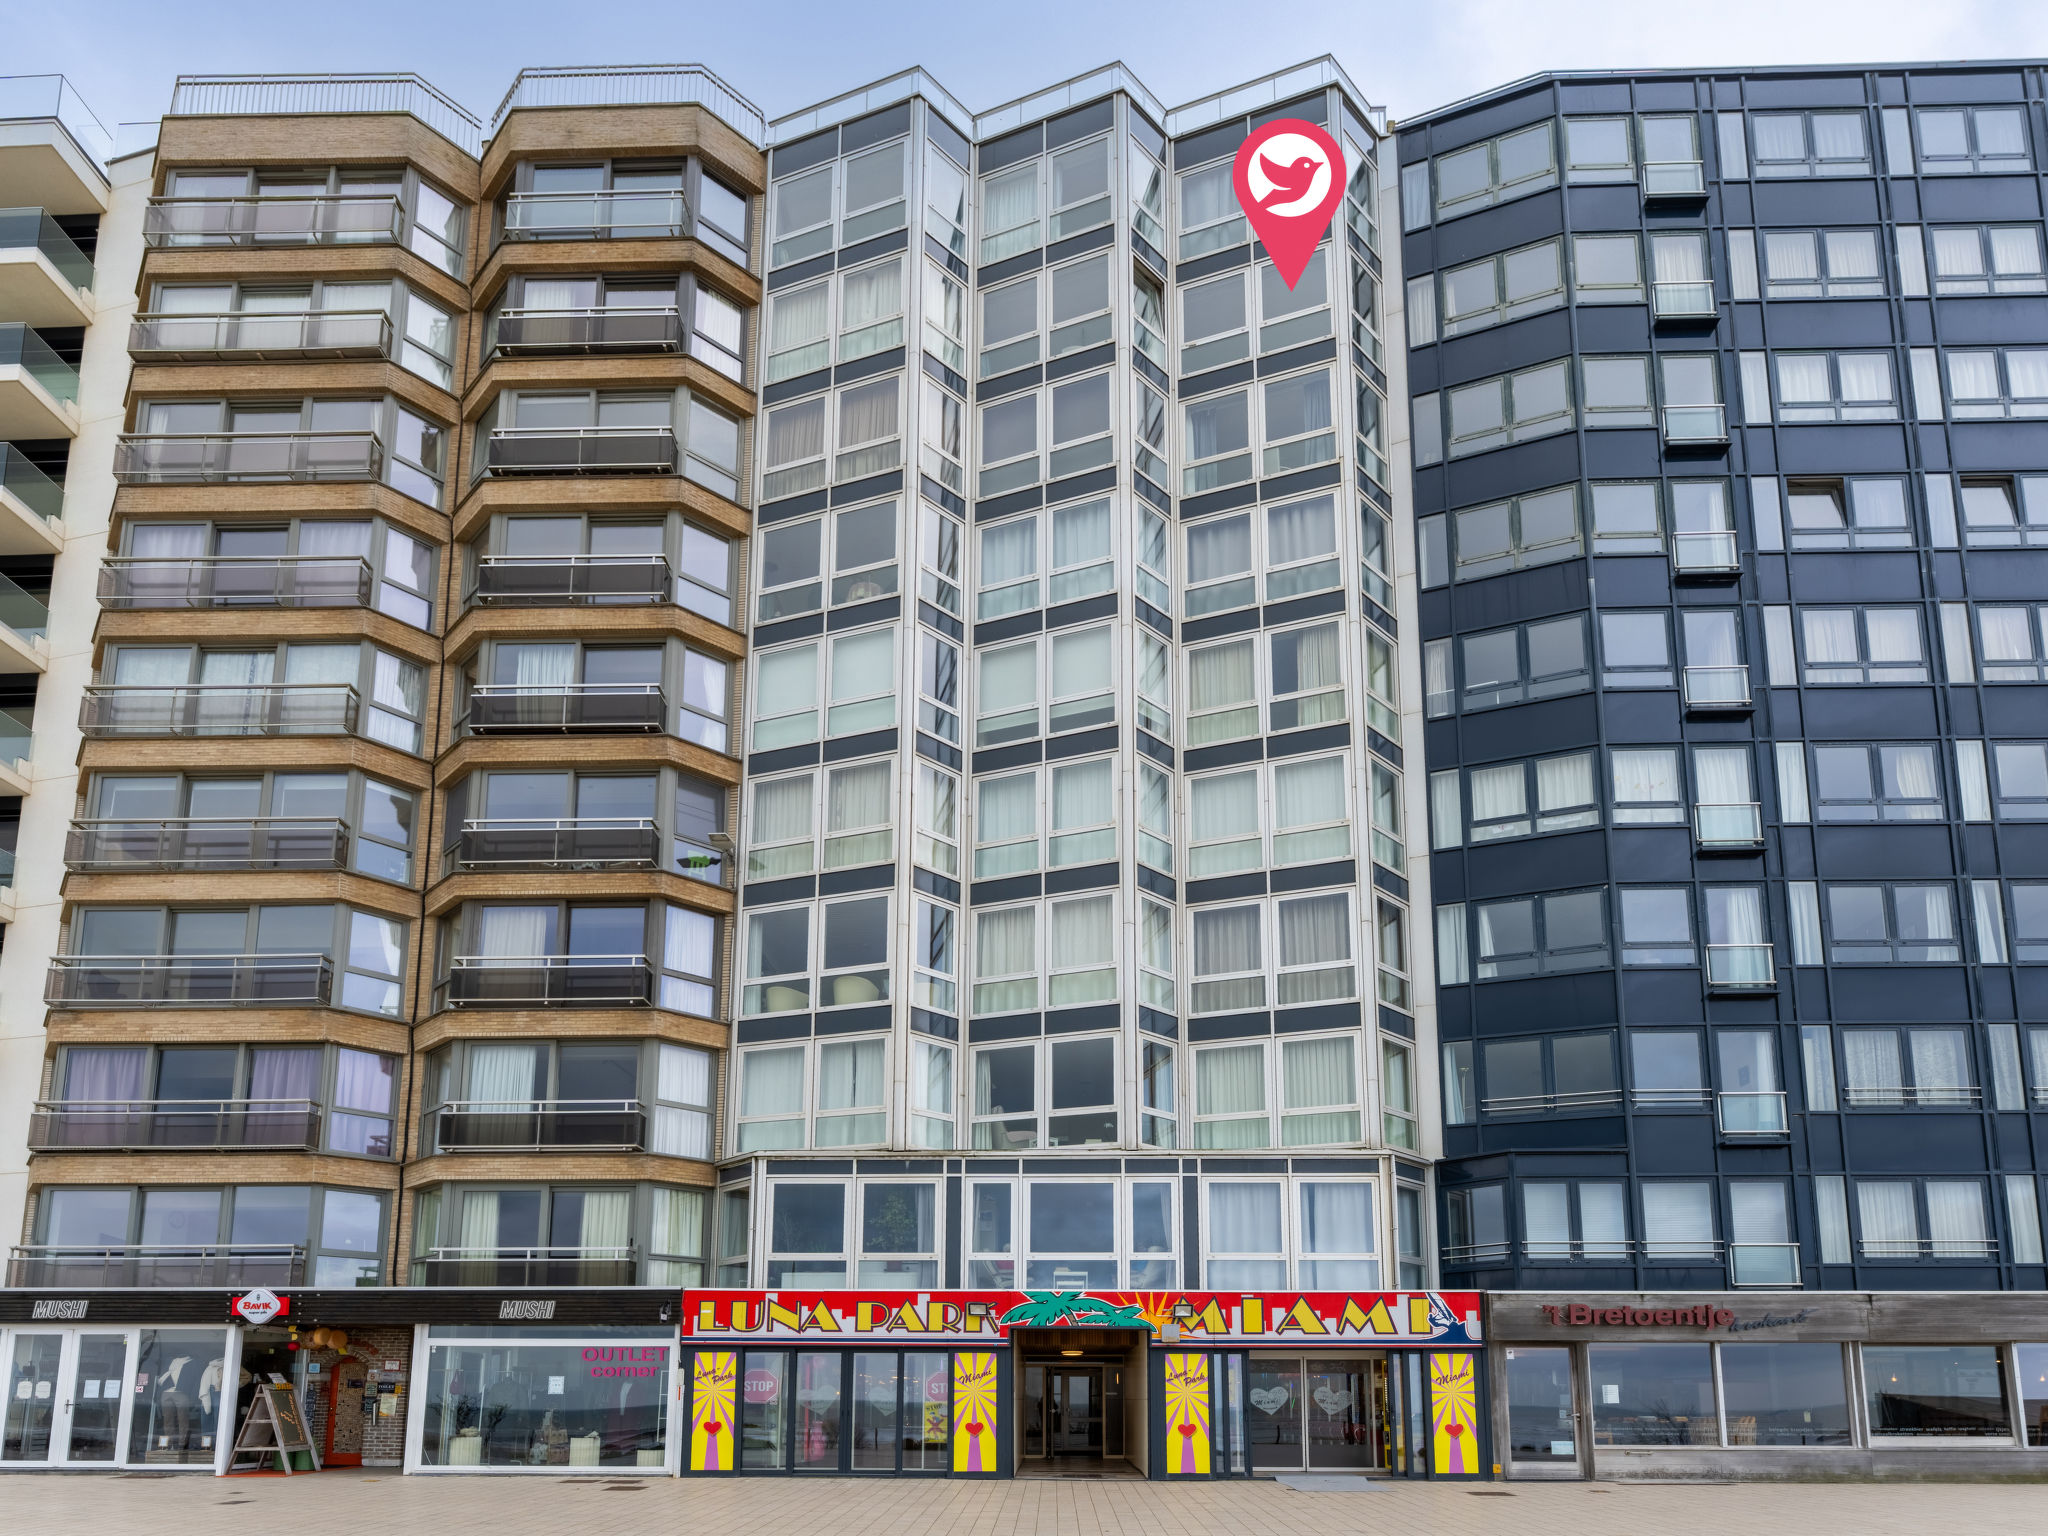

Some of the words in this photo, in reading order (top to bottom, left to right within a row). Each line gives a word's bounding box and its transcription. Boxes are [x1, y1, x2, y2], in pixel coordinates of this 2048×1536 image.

[32, 1300, 89, 1319] MUSHI
[500, 1301, 556, 1319] MUSHI
[697, 1298, 843, 1334] LUNA
[855, 1298, 1000, 1334] PARK
[1171, 1295, 1433, 1336] MIAMI
[1568, 1303, 1734, 1331] Bretoentje
[581, 1346, 669, 1362] OUTLET
[590, 1366, 659, 1378] corner
[695, 1366, 721, 1380] Luna-
[711, 1371, 733, 1385] Park
[958, 1368, 992, 1385] Miami
[1166, 1368, 1193, 1382] Luna-
[1183, 1372, 1206, 1387] Park
[1435, 1368, 1470, 1386] Miami
[744, 1380, 774, 1392] STOP
